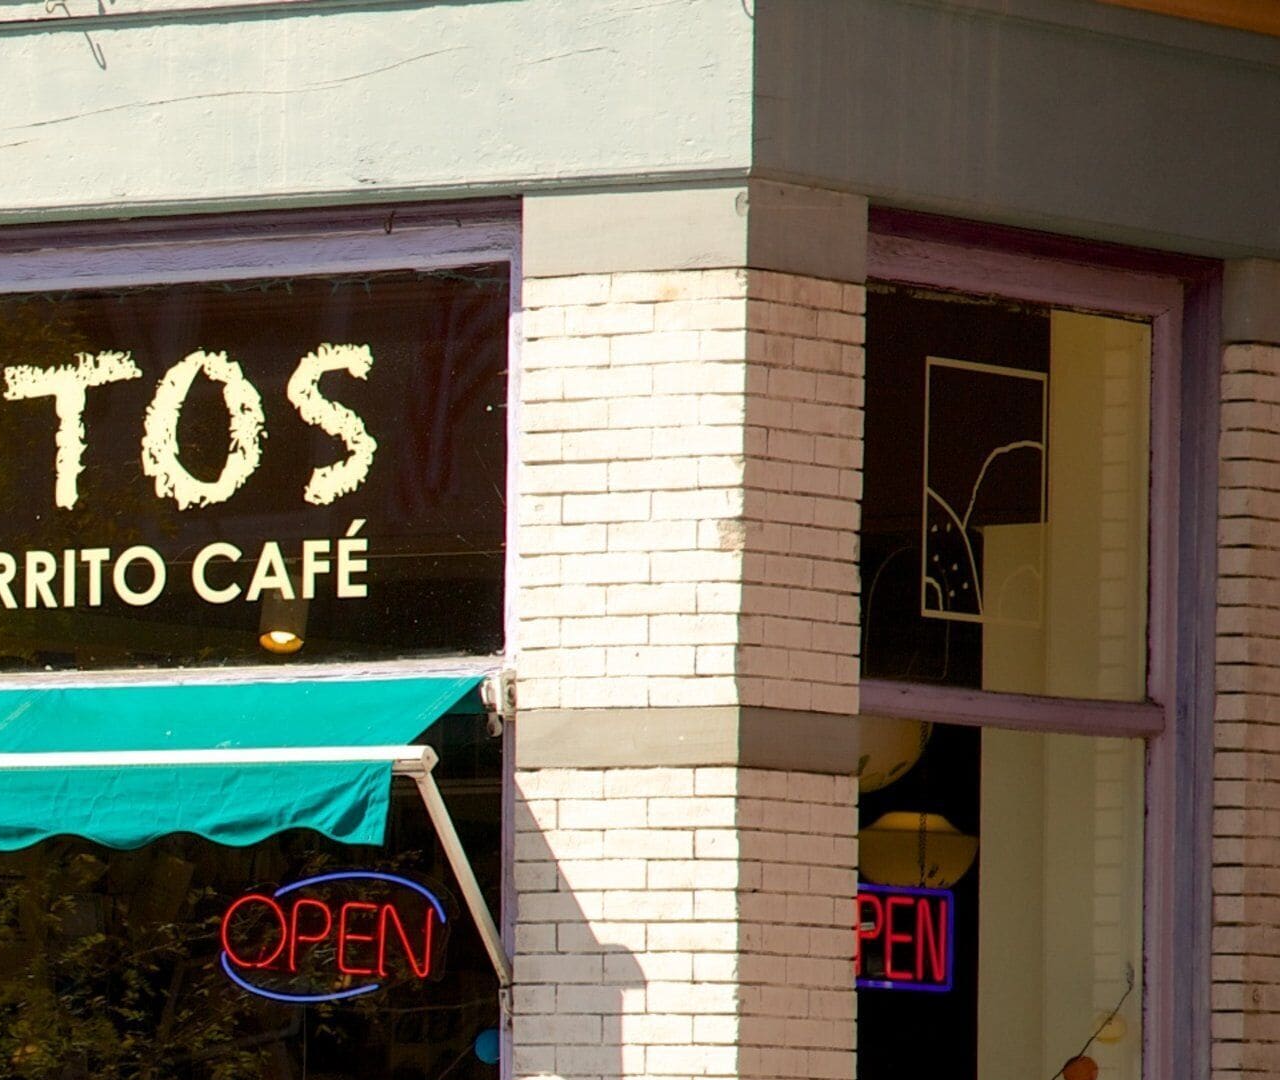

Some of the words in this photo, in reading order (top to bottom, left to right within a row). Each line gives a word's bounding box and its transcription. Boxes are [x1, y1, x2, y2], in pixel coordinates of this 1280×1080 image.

[192, 519, 368, 602] CAFÉ
[220, 895, 434, 979] OPEN
[856, 896, 947, 982] PEN
